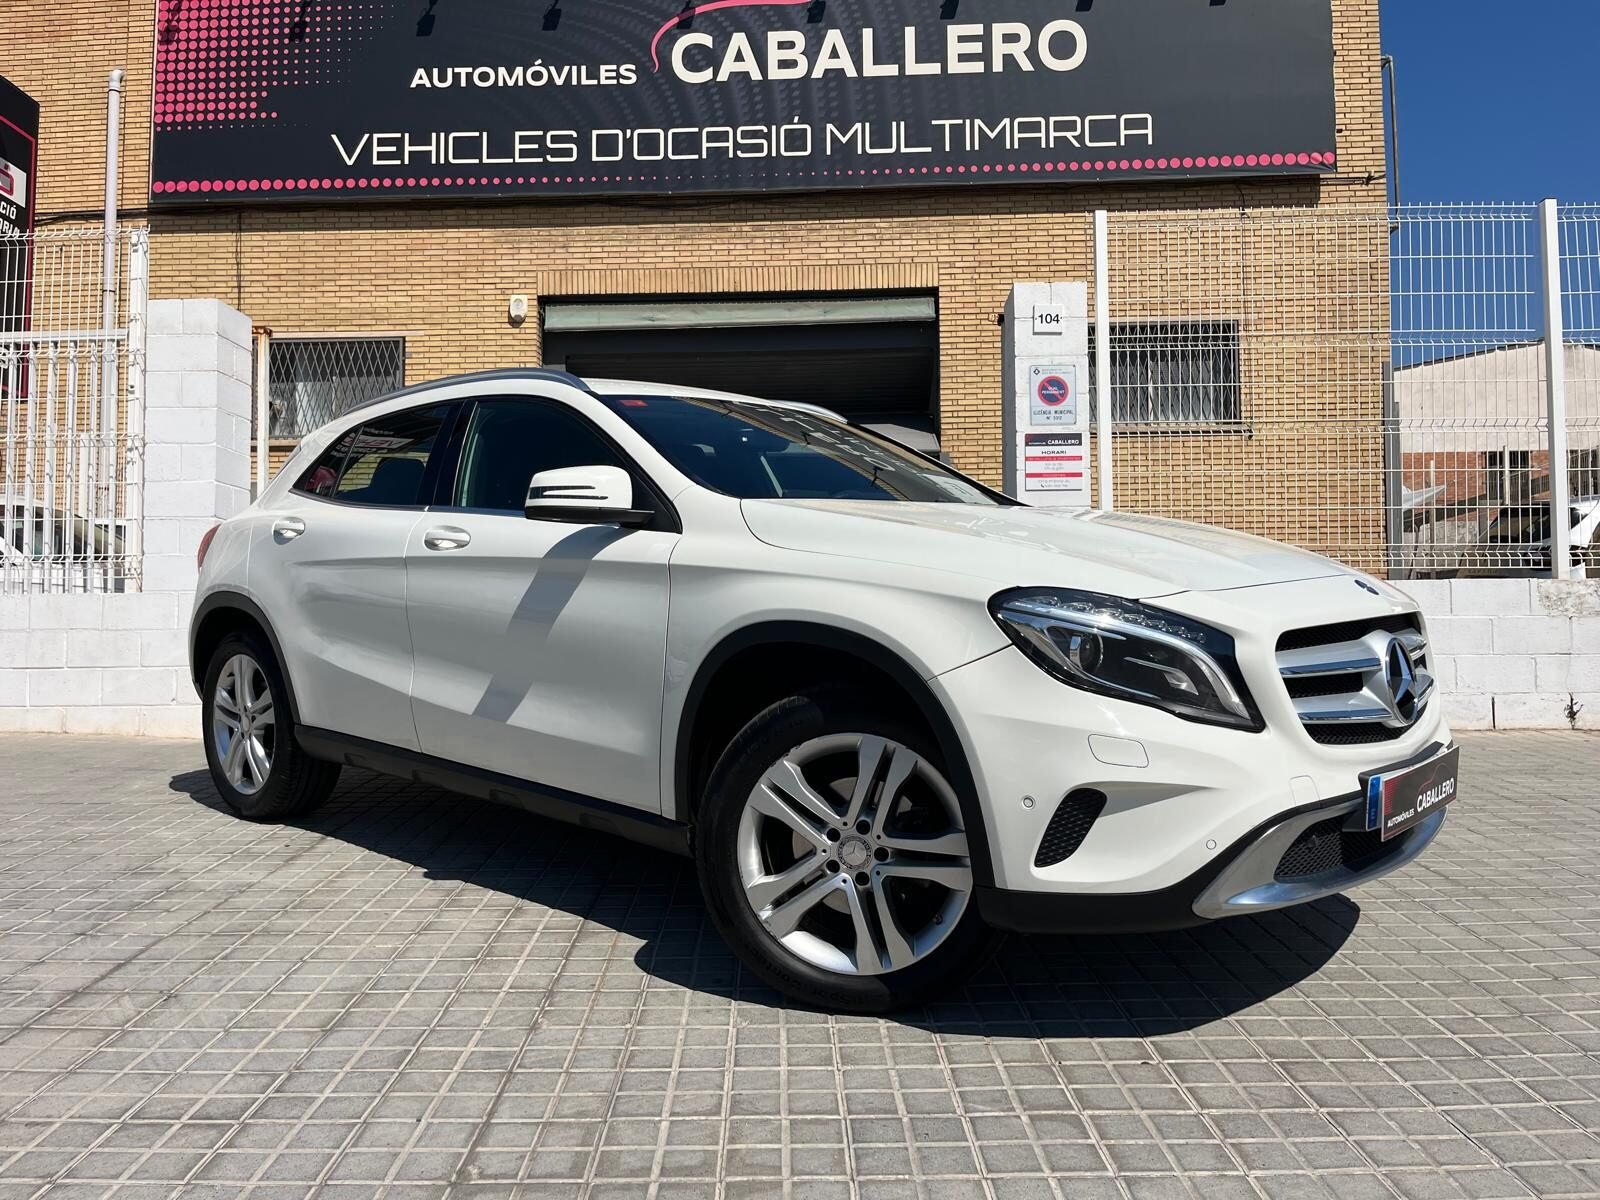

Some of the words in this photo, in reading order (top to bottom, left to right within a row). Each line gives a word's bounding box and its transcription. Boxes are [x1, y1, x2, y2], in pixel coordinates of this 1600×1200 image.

[410, 58, 638, 88] AUTOMÓVILES
[671, 19, 1088, 84] CABALLERO
[331, 130, 578, 166] VEHICLES
[591, 115, 812, 163] D'OCASIÓ
[825, 113, 1153, 157] MULTIMARCA
[1038, 313, 1061, 325] 104
[1416, 777, 1455, 813] CABALLERO
